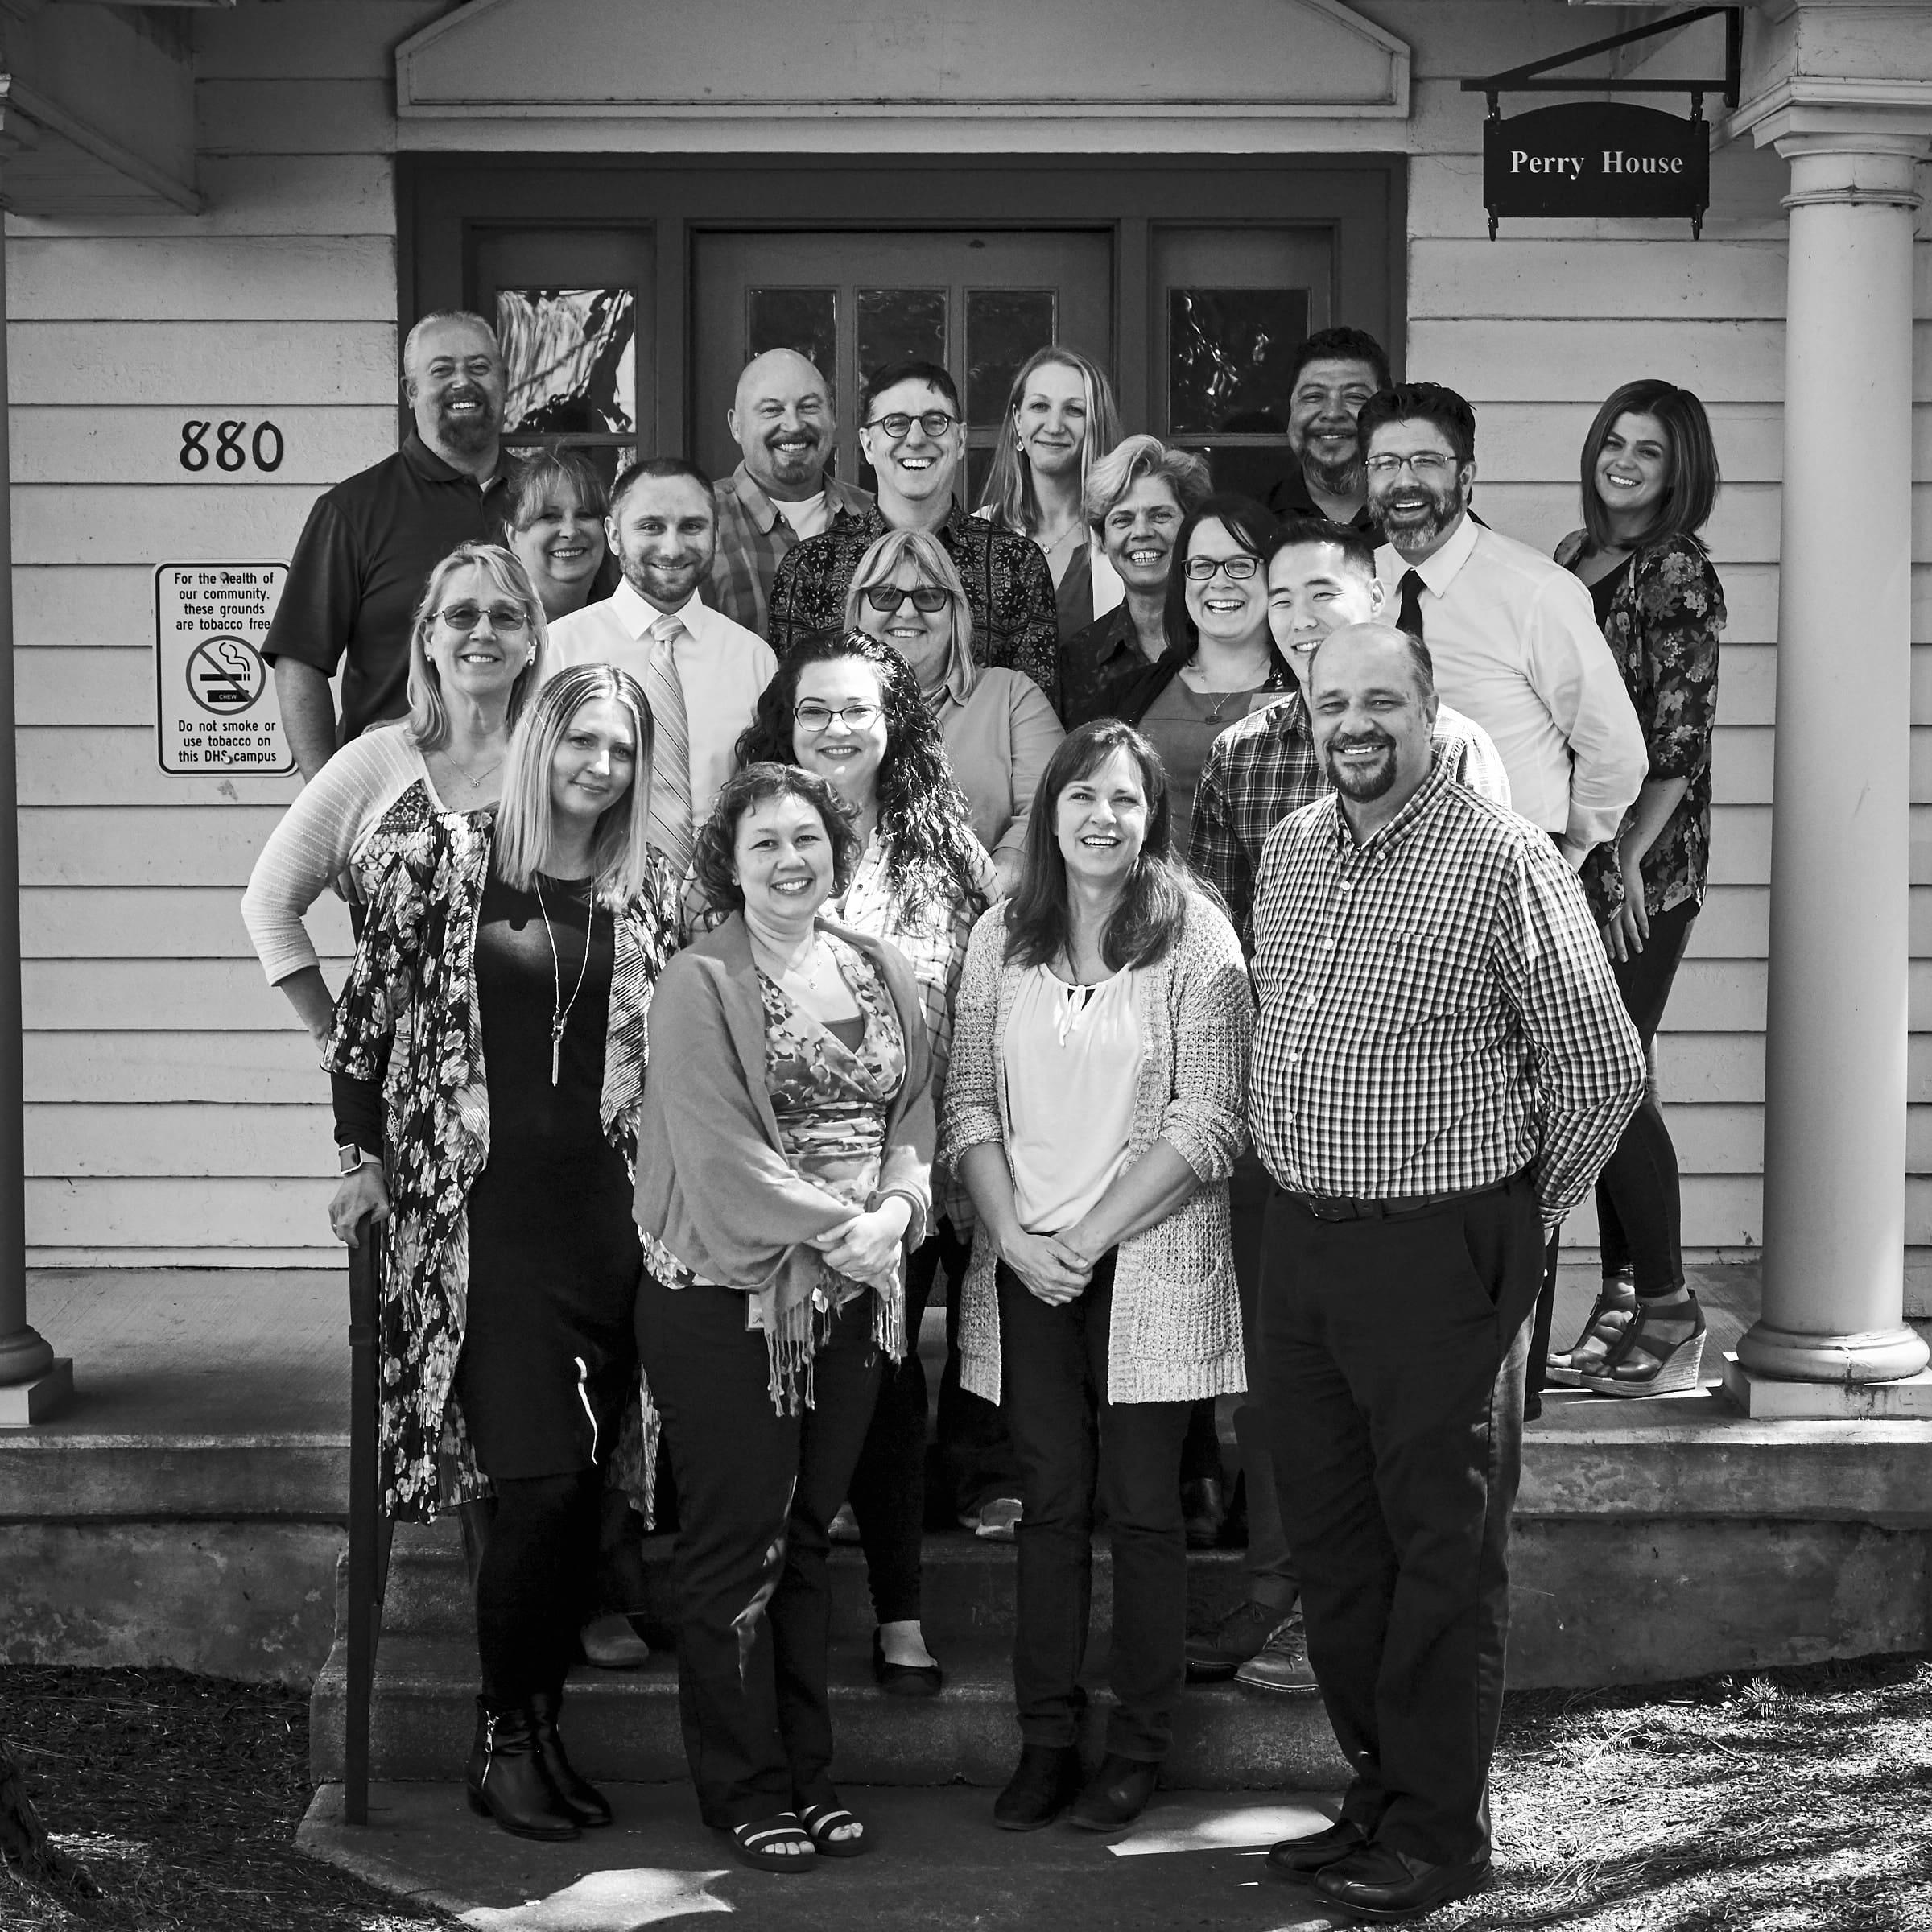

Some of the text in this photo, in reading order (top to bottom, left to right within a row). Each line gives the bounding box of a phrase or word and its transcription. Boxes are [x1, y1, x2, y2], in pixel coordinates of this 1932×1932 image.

[1509, 151, 1683, 180] Perry House
[180, 420, 284, 473] 880
[175, 572, 192, 584] For
[199, 572, 217, 584] the
[263, 572, 274, 584] of
[179, 590, 197, 600] our
[184, 603, 265, 617] these grounds
[176, 618, 271, 630] are tobacco free
[179, 720, 276, 732] Do not smoke or
[184, 736, 271, 747] use tobacco on
[178, 750, 199, 762] this
[233, 752, 277, 764] campus
